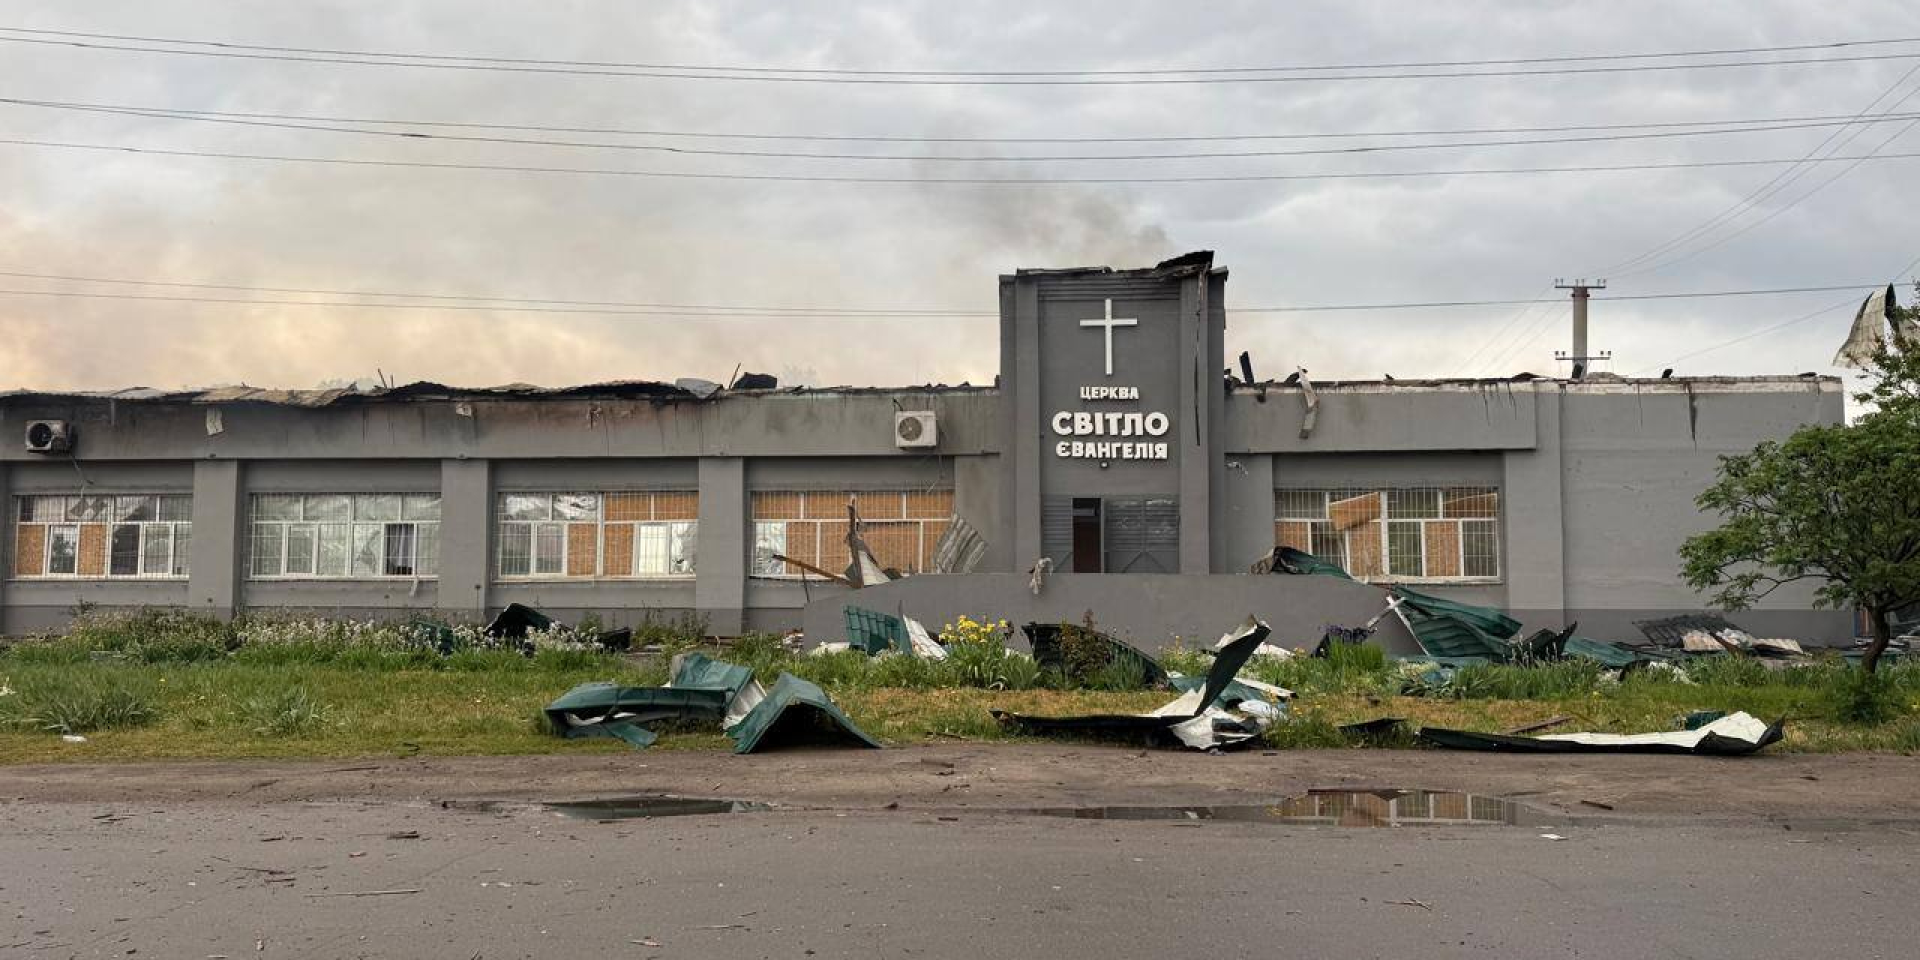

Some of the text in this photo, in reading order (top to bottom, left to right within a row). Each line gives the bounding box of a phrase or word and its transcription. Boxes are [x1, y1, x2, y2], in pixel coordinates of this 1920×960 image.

[1080, 386, 1139, 400] ЦЕРКВА
[1052, 411, 1169, 436] СВІТЛО
[1055, 441, 1168, 459] ЄВАНГЕЛІЯ
